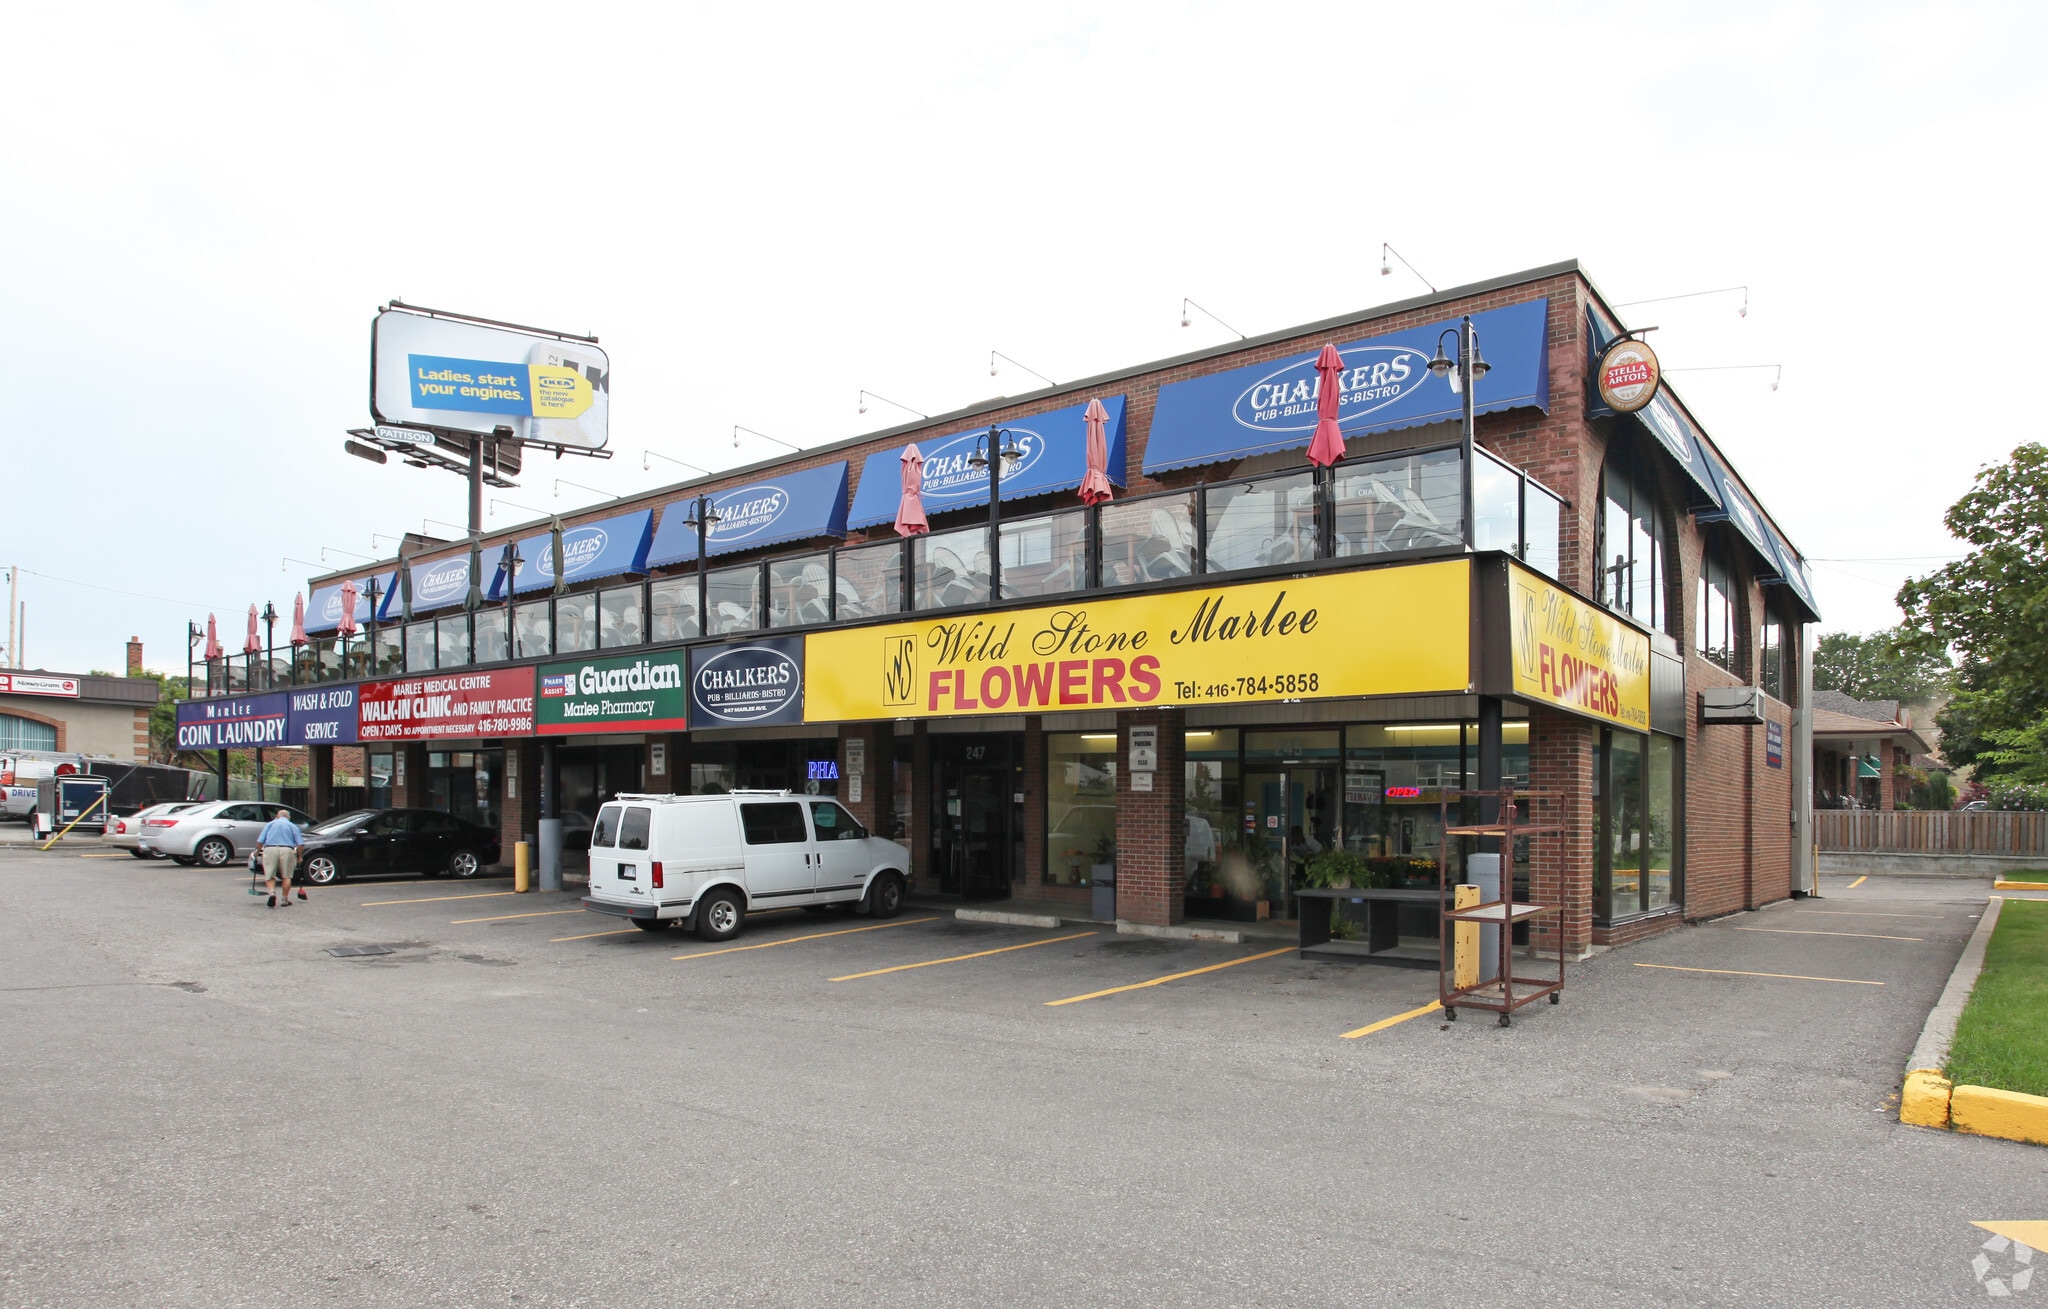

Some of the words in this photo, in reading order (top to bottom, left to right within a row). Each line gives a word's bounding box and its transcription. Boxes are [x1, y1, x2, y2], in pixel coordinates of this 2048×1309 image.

[418, 368, 474, 385] Ladies,
[478, 375, 516, 387] start
[1608, 364, 1646, 378] STELLA
[1608, 372, 1648, 386] ARTOIS
[418, 382, 457, 396] your
[460, 386, 524, 401] engines.
[540, 396, 574, 404] catalogue
[1254, 408, 1276, 422] PUB
[1353, 384, 1400, 403] BISTRO
[380, 429, 430, 442] PATTISON
[922, 478, 938, 490] PUB
[424, 566, 469, 588] CHALKERS
[926, 621, 1016, 666] Wild
[1031, 610, 1148, 656] Stone
[1170, 591, 1318, 645] Marlee
[1542, 589, 1577, 645] Wild
[1578, 610, 1611, 662] Stone
[1613, 632, 1644, 676] Marlee
[394, 682, 422, 696] MARLEE
[424, 678, 458, 694] MEDICAL
[460, 675, 490, 690] CENTRE
[579, 660, 681, 695] Guardian
[702, 662, 790, 690] CHALKERS
[928, 654, 1161, 712] FLOWERS
[1540, 642, 1618, 718] FLOWERS
[708, 694, 720, 702] PUB
[724, 690, 760, 700] BILLIARDS
[762, 688, 786, 698] BISTRO
[1174, 681, 1200, 700] Tel:
[293, 694, 318, 712] WASH
[320, 693, 327, 708] &
[328, 690, 352, 708] FOLD
[362, 698, 410, 722] WALK-IN
[413, 694, 452, 718] CLINIC
[452, 702, 468, 716] AND
[470, 700, 496, 714] FAMILY
[496, 698, 532, 713] PRACTICE
[564, 702, 600, 717] Marlee
[600, 700, 655, 716] Pharmacy
[178, 725, 211, 746] COIN
[217, 718, 286, 744] LAUNDRY
[304, 722, 338, 740] SERVICE
[362, 725, 380, 736] OPEN
[380, 725, 384, 736] 7
[384, 724, 402, 736] DAYS
[404, 727, 412, 736] NO
[412, 725, 445, 734] APPOINTMENT
[446, 723, 474, 734] NECESSARY
[478, 718, 532, 732] 416-780-9986
[966, 746, 985, 760] 247
[12, 789, 36, 798] DRIVE
[1387, 786, 1420, 797] OPEN
